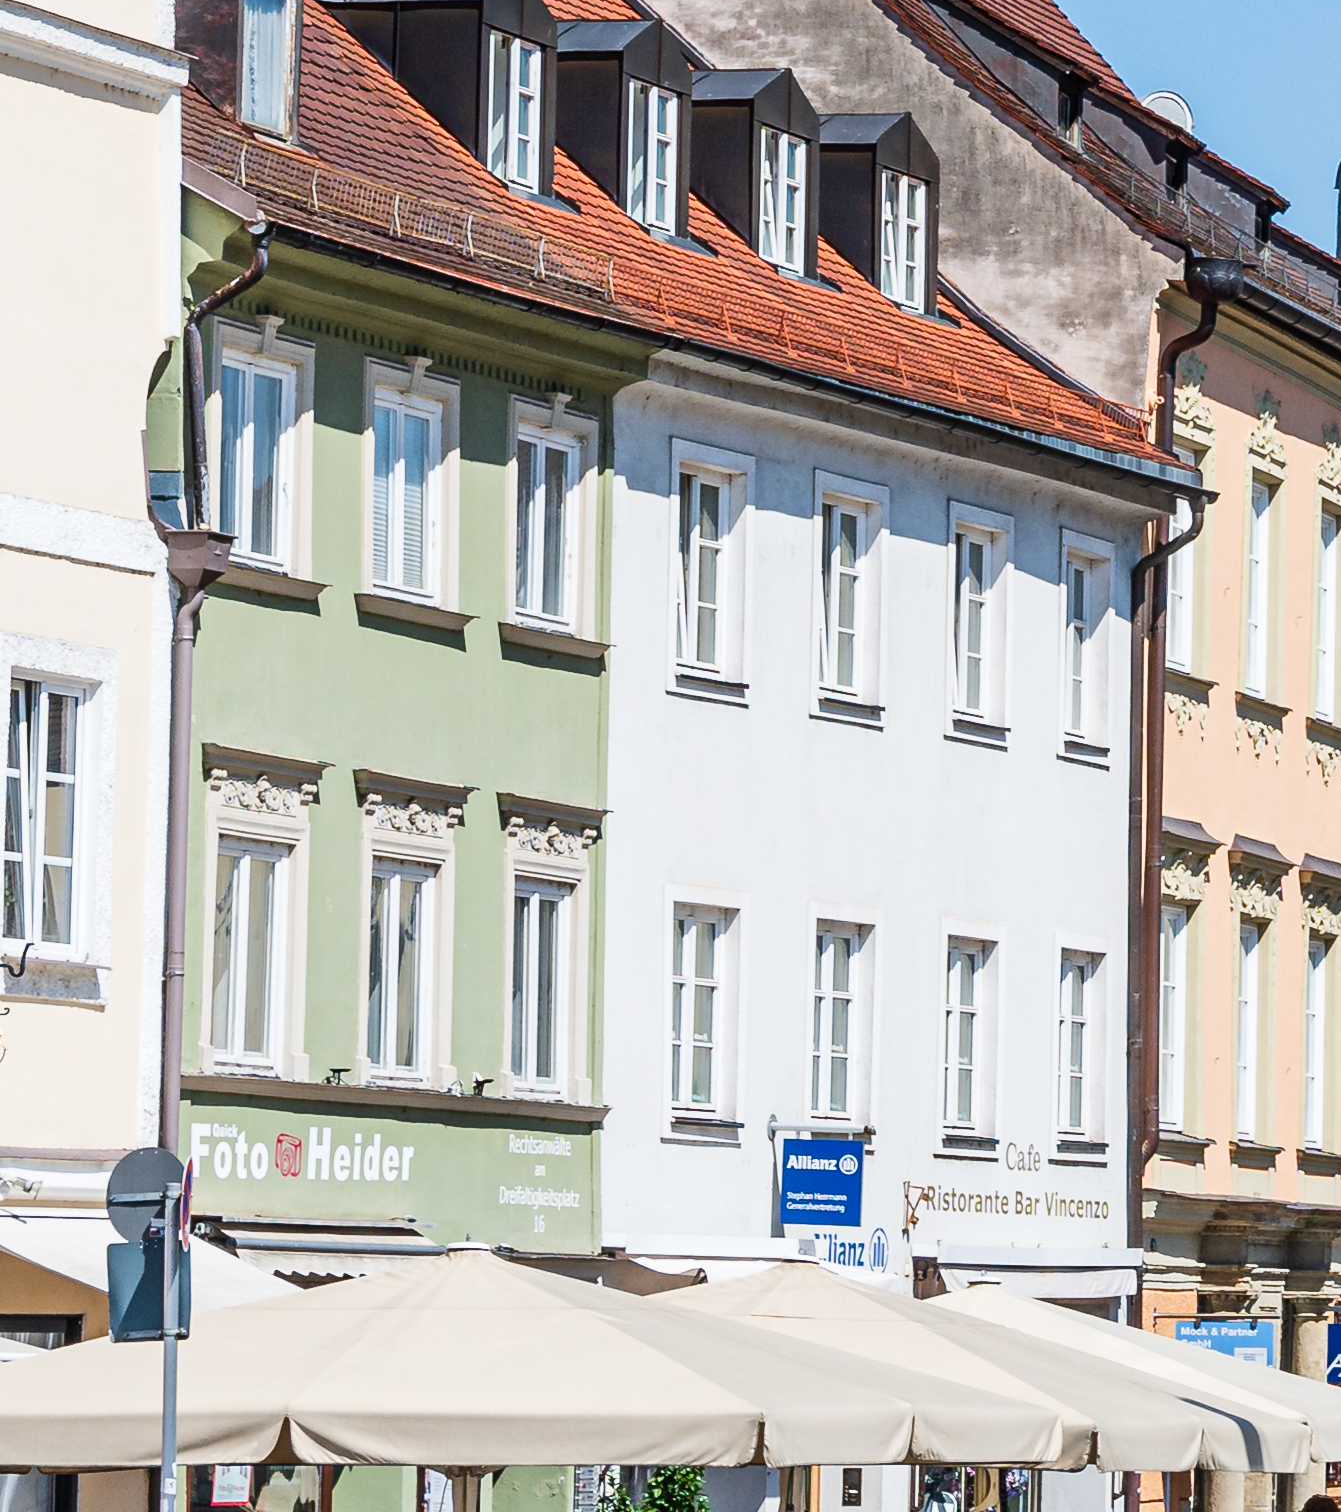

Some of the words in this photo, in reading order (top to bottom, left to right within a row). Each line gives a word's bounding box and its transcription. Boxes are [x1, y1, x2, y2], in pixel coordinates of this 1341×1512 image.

[212, 1123, 238, 1138] Quick
[191, 1123, 269, 1180] Foto
[306, 1126, 415, 1182] Heider
[508, 1133, 571, 1156] Rechtsanwälte
[786, 1154, 838, 1170] Allianz
[1006, 1141, 1041, 1172] Cafe
[534, 1164, 546, 1177] am
[499, 1185, 580, 1211] Dreifaltigkeitsplatz
[926, 1185, 1009, 1215] Ristorante
[1015, 1190, 1040, 1215] Bar
[1045, 1192, 1109, 1220] Vincenzo
[534, 1214, 545, 1233] 16
[814, 1233, 865, 1266] lianz
[1180, 1326, 1209, 1337] Mock
[1211, 1326, 1219, 1337] &
[1221, 1327, 1259, 1337] Partner
